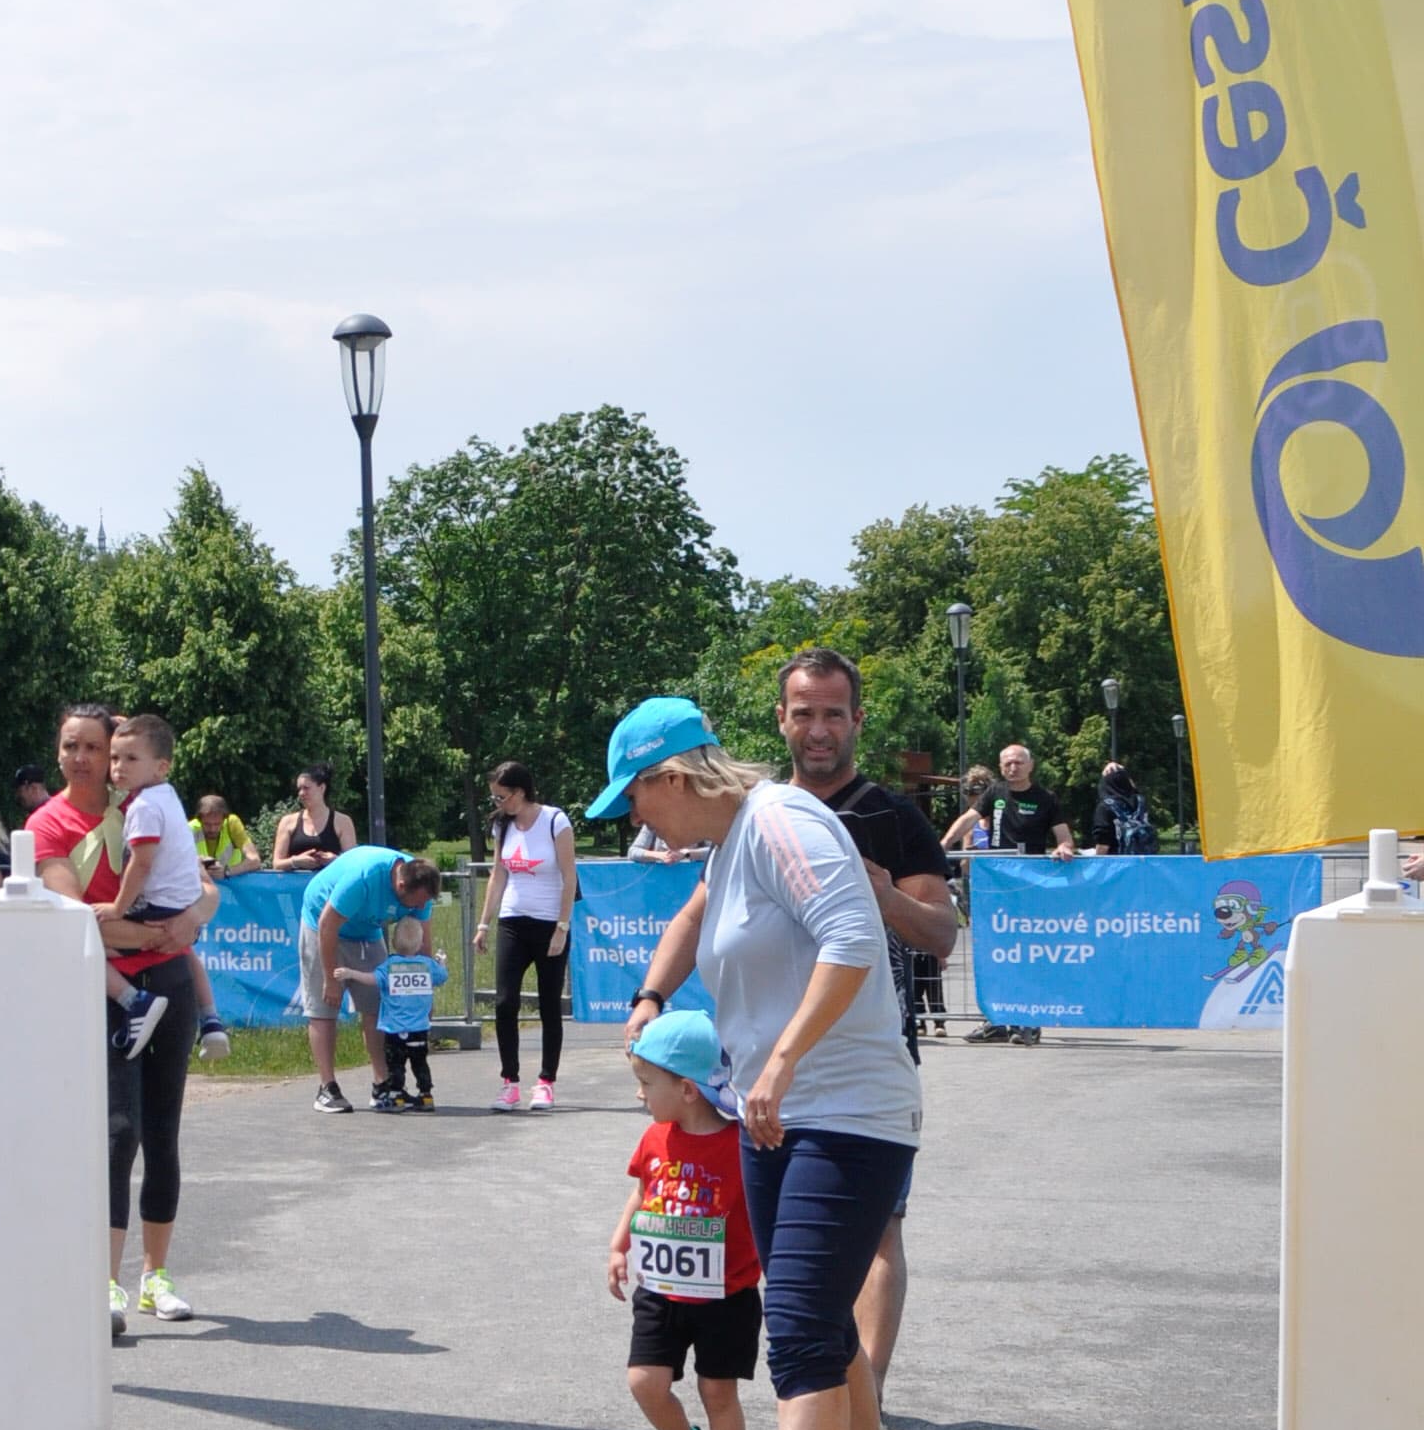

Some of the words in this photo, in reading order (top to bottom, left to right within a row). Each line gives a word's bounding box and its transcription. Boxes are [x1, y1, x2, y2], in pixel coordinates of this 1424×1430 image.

[586, 915, 672, 940] Pojistím
[992, 908, 1089, 934] Úrazové
[1095, 911, 1201, 938] pojištění
[215, 923, 292, 946] rodinu,
[992, 943, 1022, 964] od
[1029, 945, 1095, 964] PVZP
[393, 974, 428, 988] 2062
[992, 1002, 1084, 1016] www.pvzp.cz
[674, 1218, 722, 1238] HELP
[639, 1239, 711, 1279] 2061
